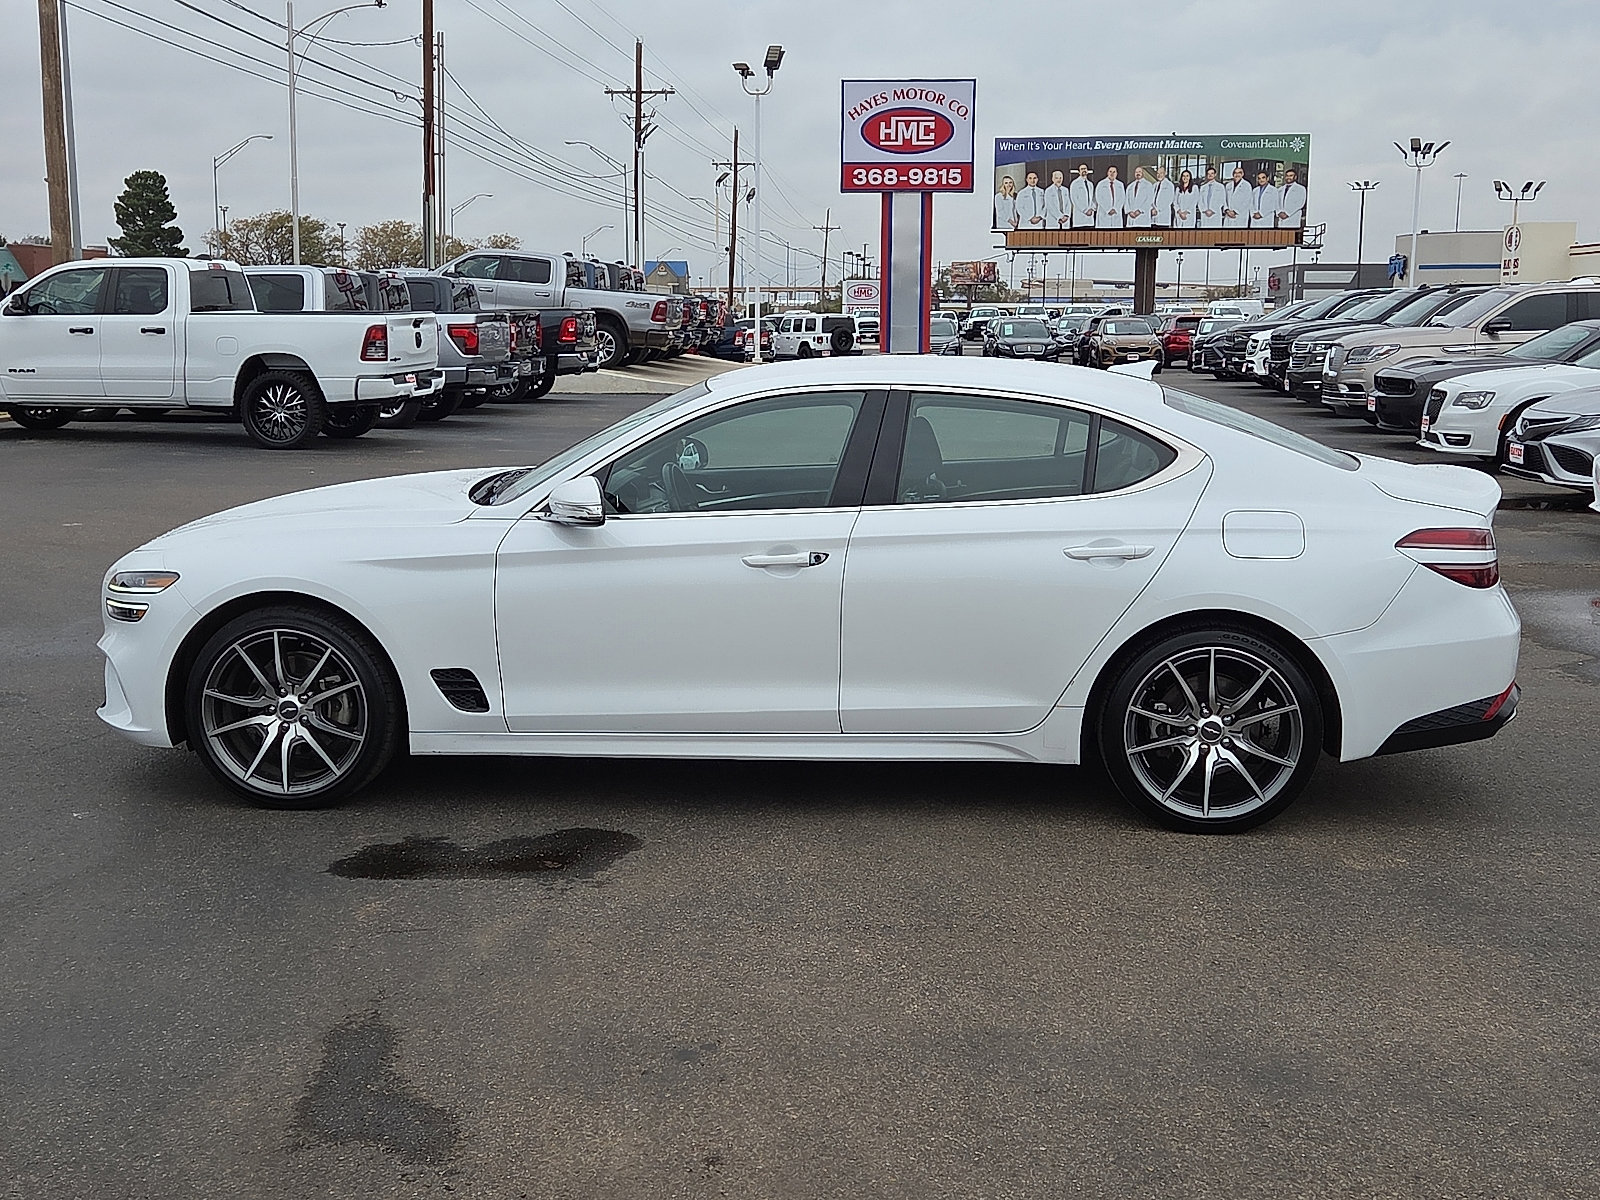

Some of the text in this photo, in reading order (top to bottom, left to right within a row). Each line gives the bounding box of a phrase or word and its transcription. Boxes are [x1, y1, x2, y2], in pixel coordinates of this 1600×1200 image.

[848, 88, 969, 120] HAYES MOTOR CO.
[879, 116, 935, 145] HMC
[999, 141, 1025, 151] When
[1027, 141, 1040, 150] It's
[1042, 141, 1063, 150] Your
[1094, 140, 1122, 151] Every
[1123, 140, 1165, 149] Moment
[1165, 139, 1204, 149] Matters.
[852, 168, 962, 185] 368-9815
